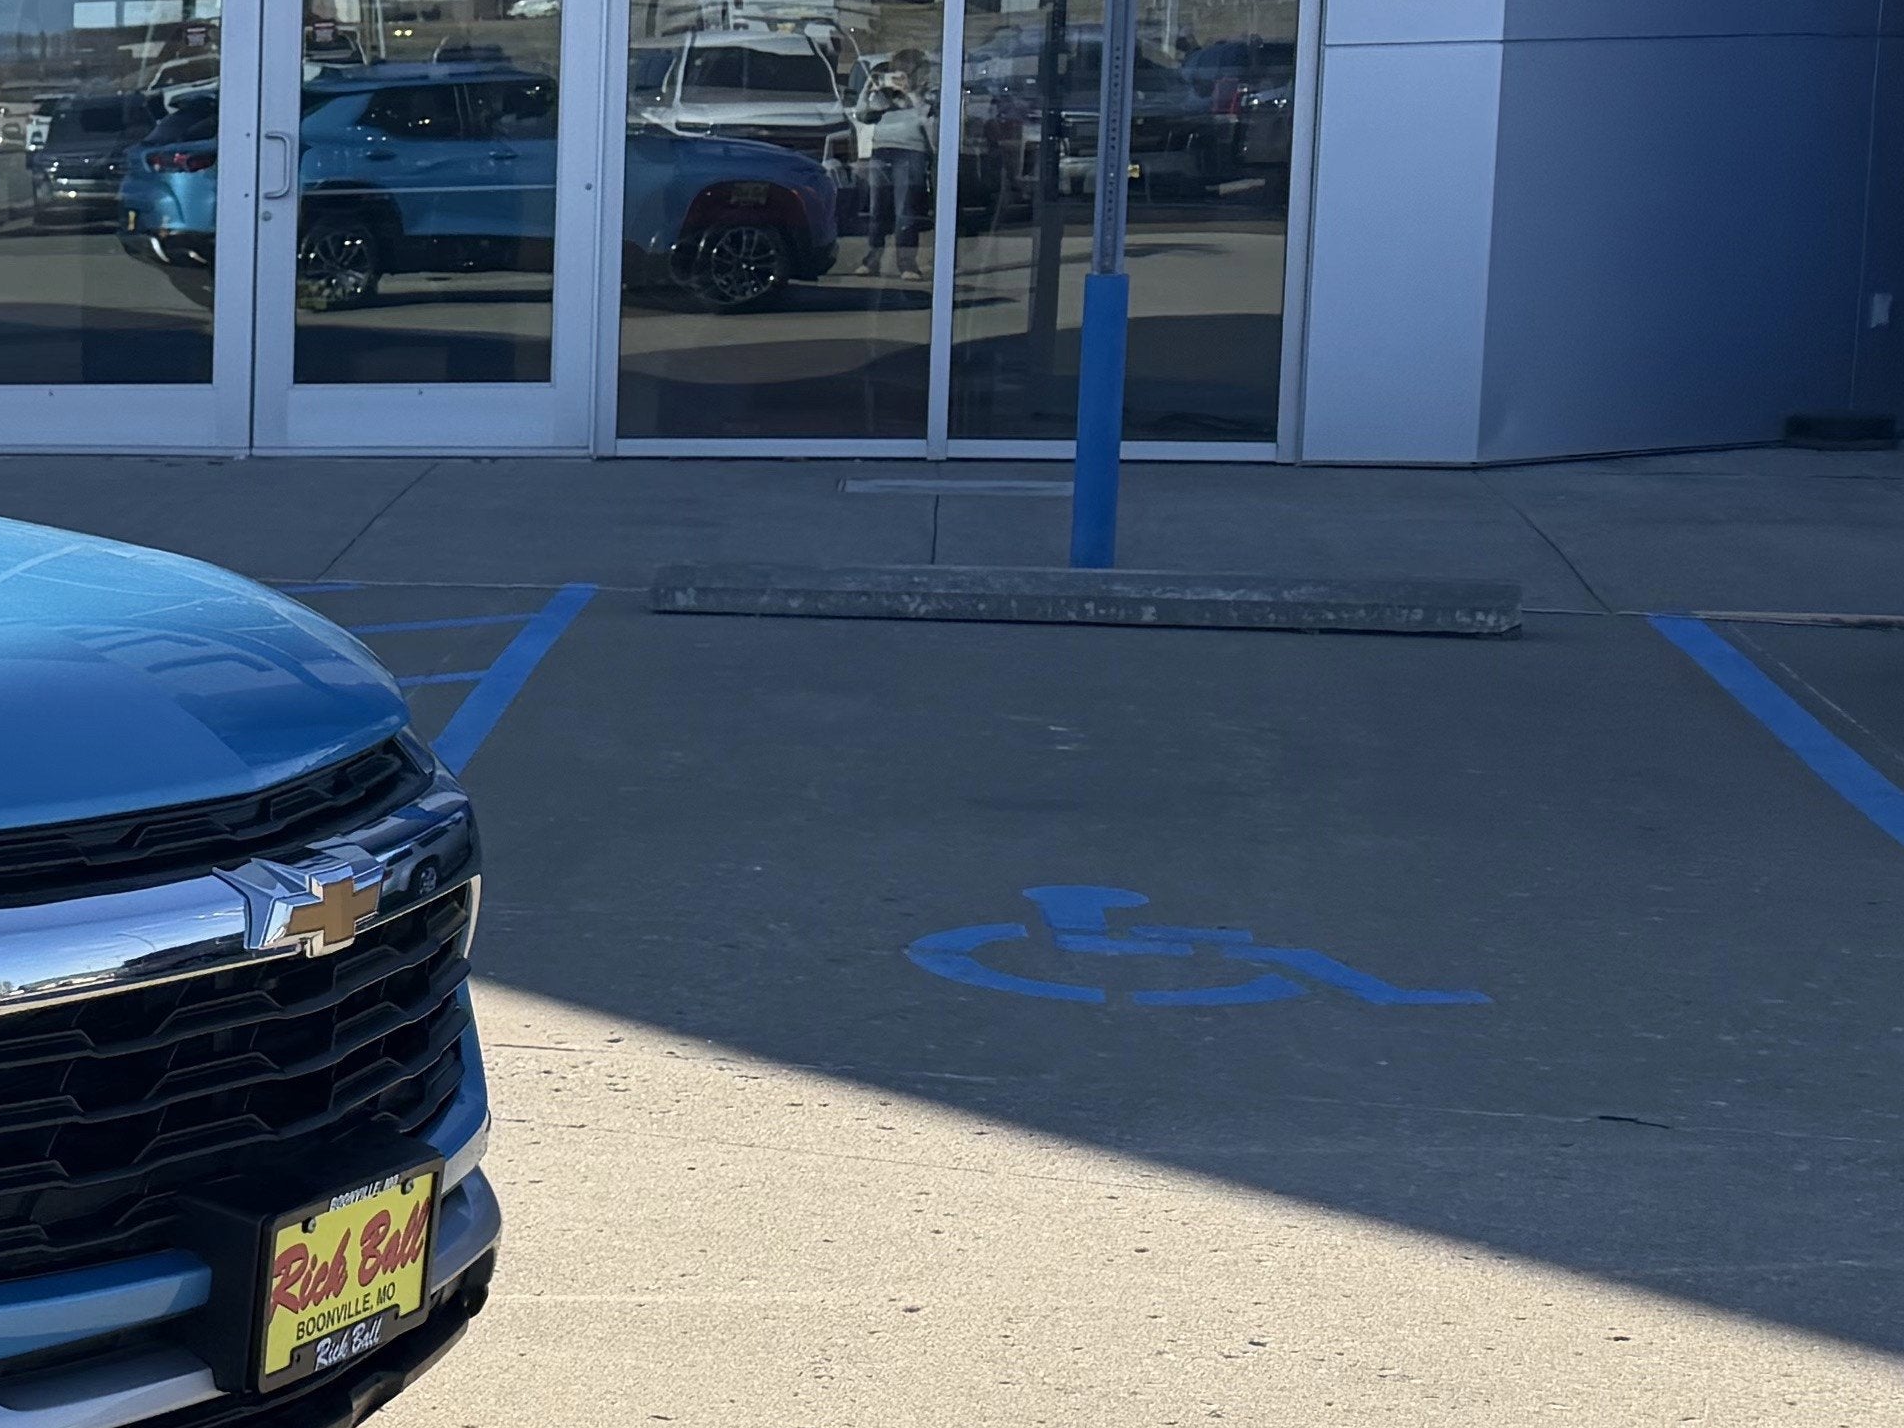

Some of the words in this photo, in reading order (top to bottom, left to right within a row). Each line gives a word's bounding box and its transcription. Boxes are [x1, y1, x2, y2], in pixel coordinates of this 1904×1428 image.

[269, 1228, 351, 1324] Rick
[358, 1196, 432, 1288] Ball
[296, 1292, 373, 1340] BOONVILLE,
[377, 1282, 396, 1306] MO
[315, 1336, 348, 1371] Rick
[351, 1318, 382, 1354] Ball
